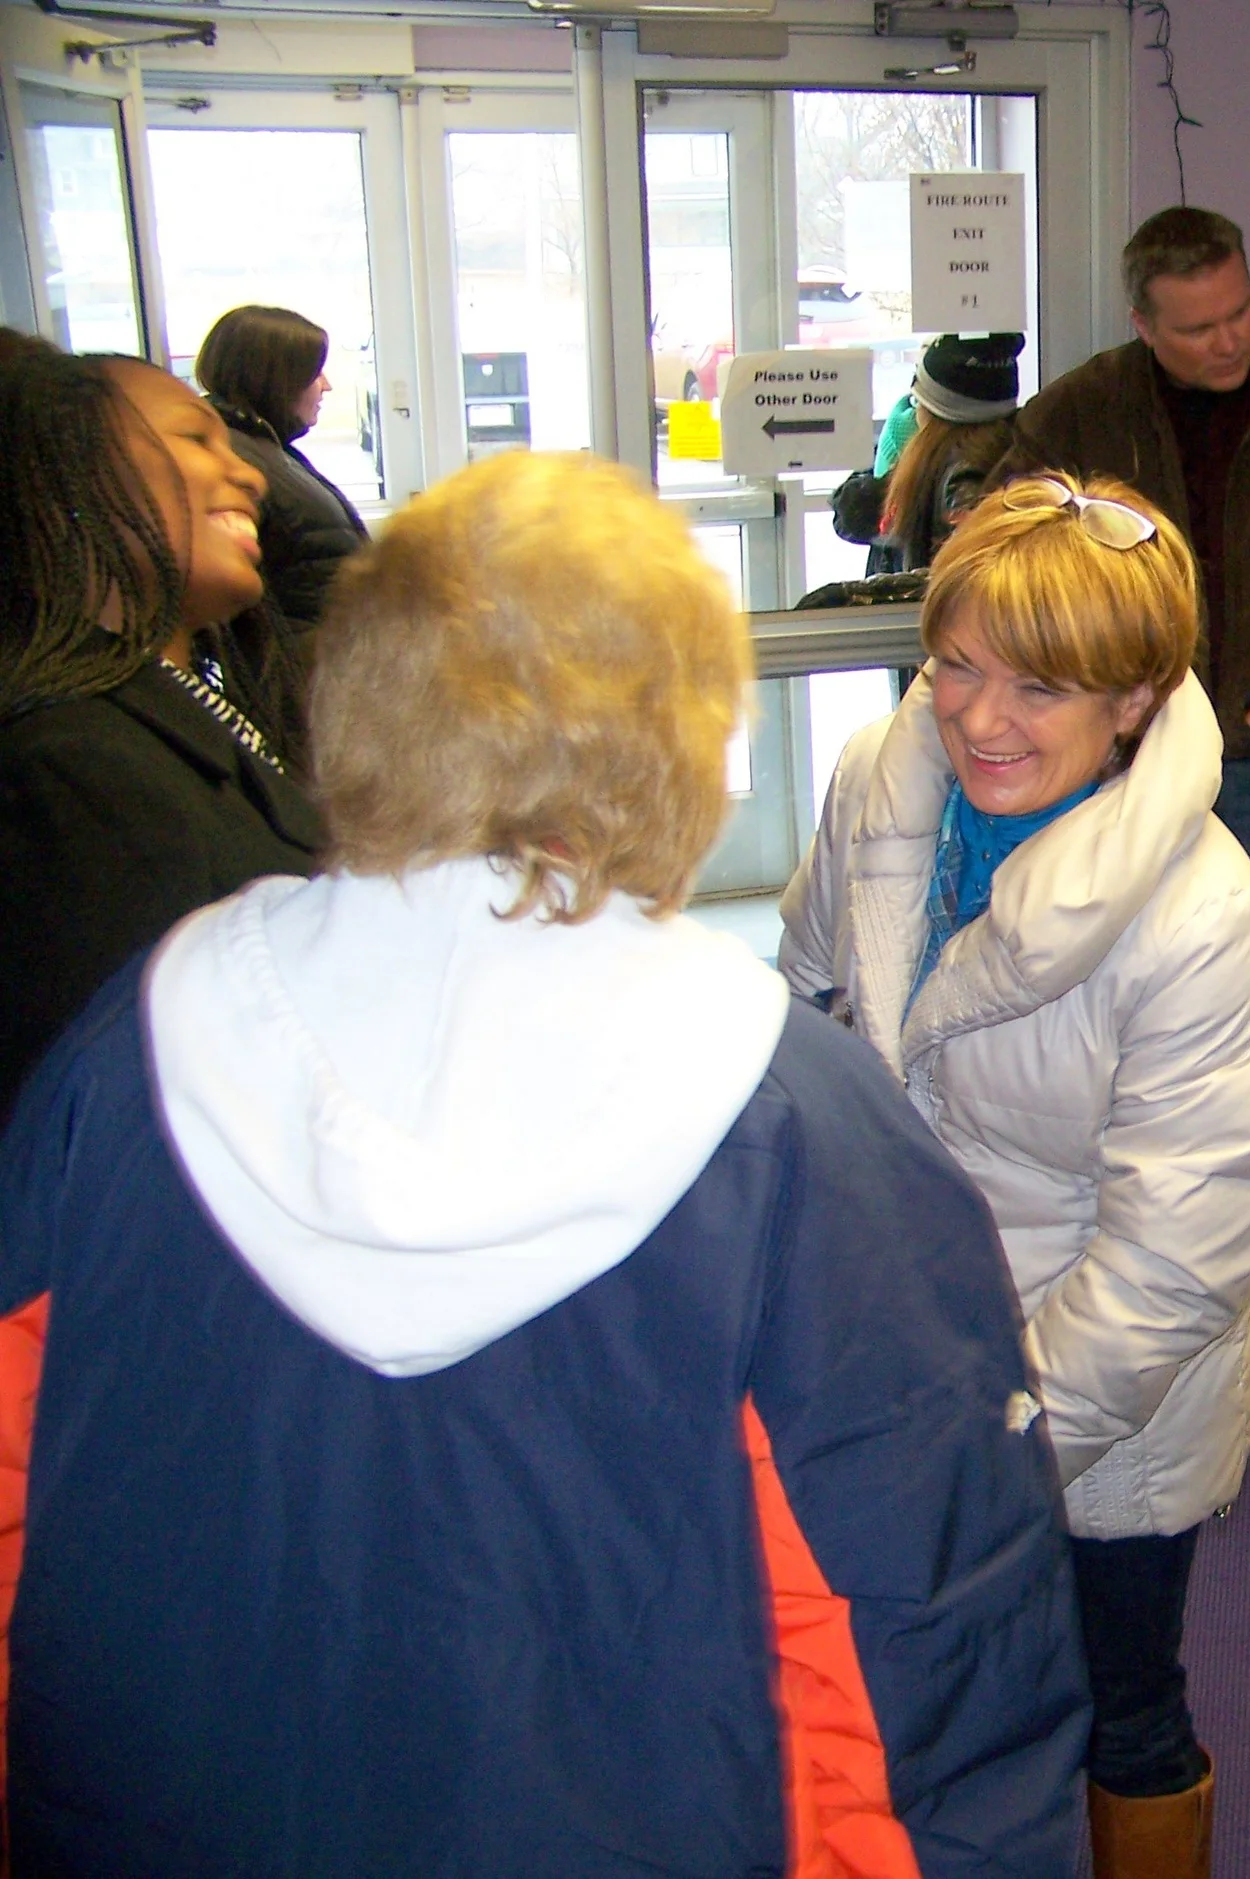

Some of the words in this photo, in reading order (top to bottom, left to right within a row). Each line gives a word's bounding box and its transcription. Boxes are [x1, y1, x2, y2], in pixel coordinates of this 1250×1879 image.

[926, 193, 959, 208] FIRE
[962, 193, 1011, 208] ROUTE
[952, 226, 986, 241] EXIT
[948, 260, 991, 274] DOOR
[753, 369, 805, 383] Please
[808, 369, 840, 382] Use
[754, 392, 798, 407] Other
[801, 392, 839, 406] Door
